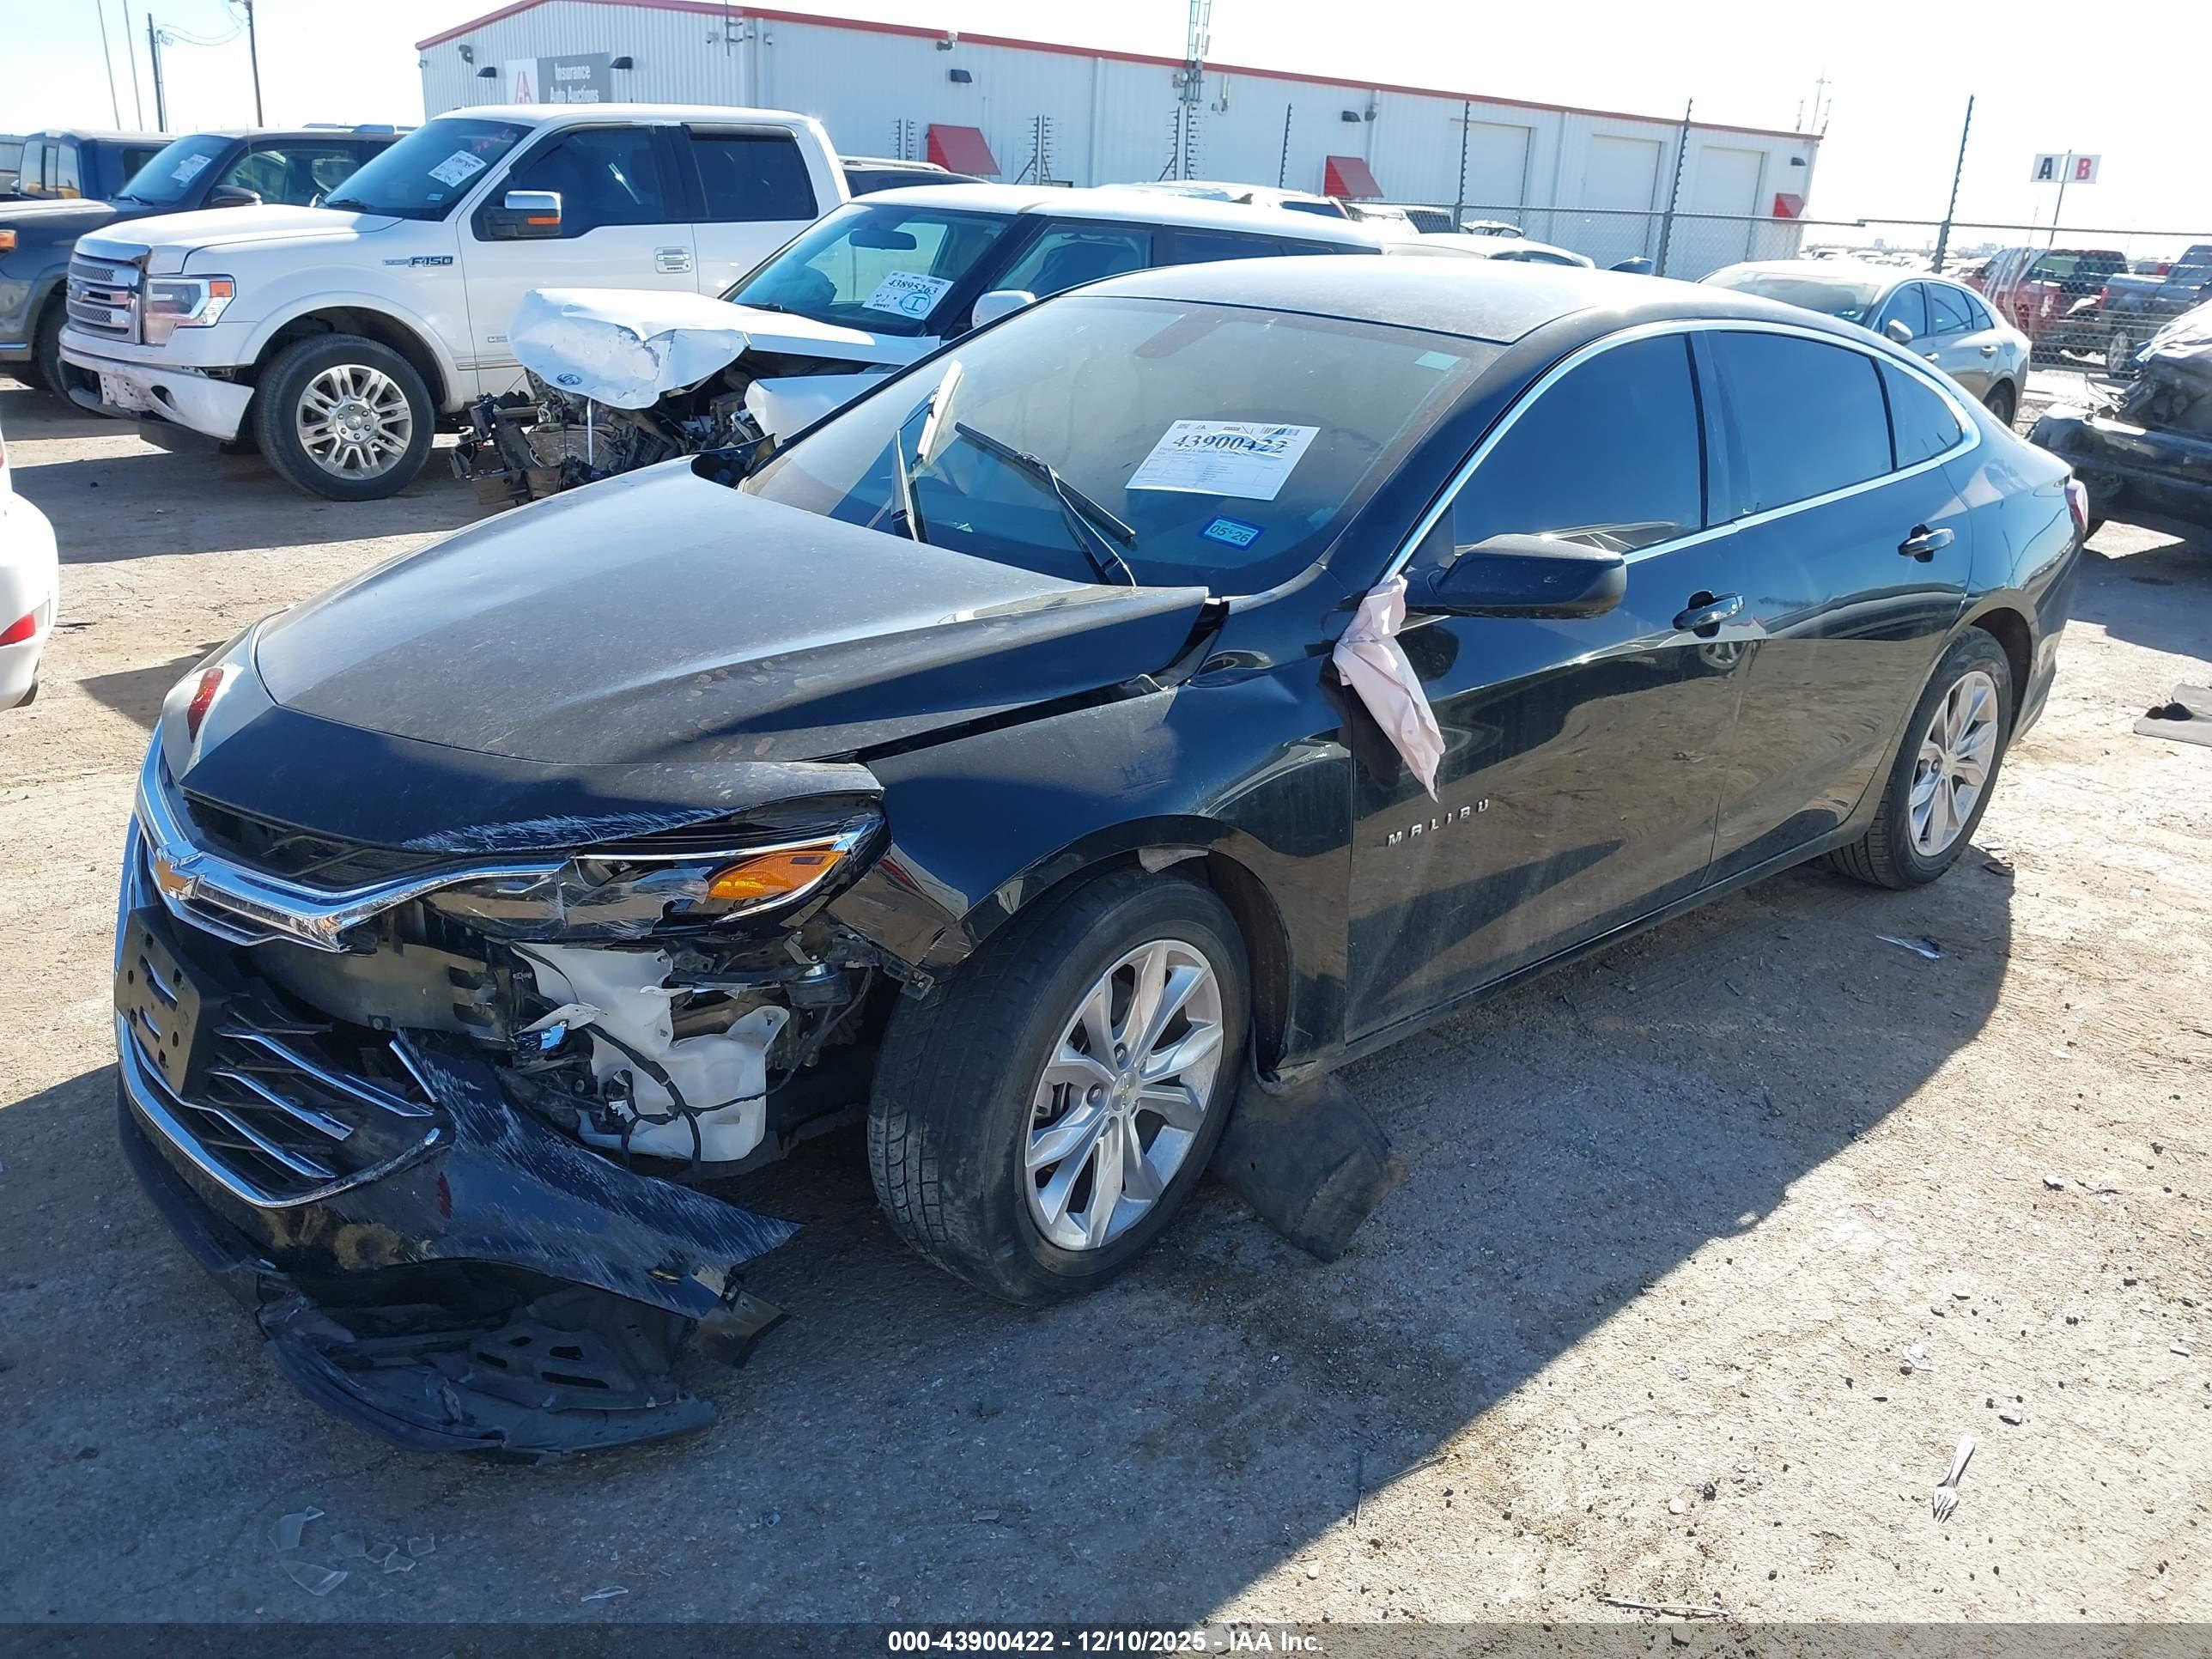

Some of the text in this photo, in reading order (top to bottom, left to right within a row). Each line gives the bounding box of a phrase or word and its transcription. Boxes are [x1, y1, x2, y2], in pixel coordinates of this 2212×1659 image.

[554, 62, 591, 81] Insurance
[550, 84, 599, 103] Auto Auctions
[2038, 157, 2092, 179] A B
[888, 279, 939, 295] 43895263
[1172, 434, 1288, 453] 43900422
[1209, 525, 1230, 537] 05
[1231, 531, 1251, 543] 26
[1386, 799, 1489, 848] MALIBU
